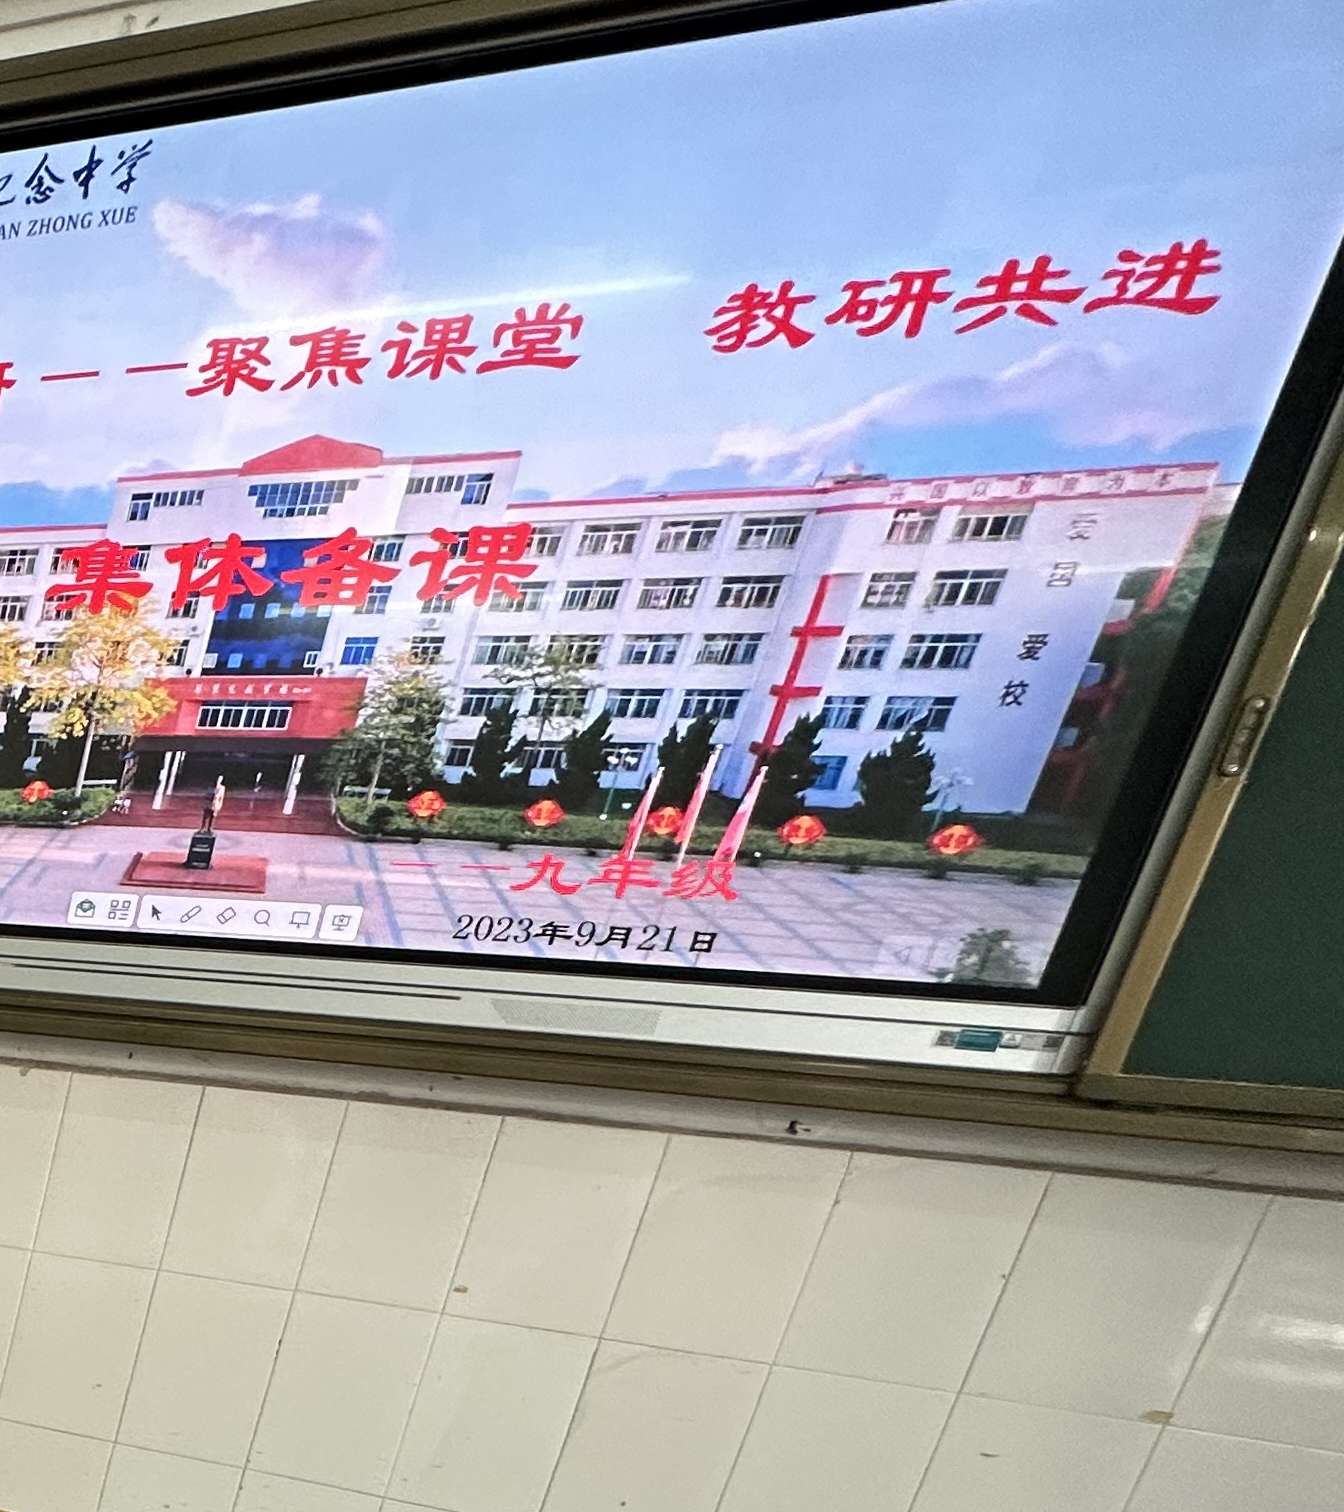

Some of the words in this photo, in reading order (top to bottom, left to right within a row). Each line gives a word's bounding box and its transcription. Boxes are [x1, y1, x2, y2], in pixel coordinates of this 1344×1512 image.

[25, 212, 93, 239] ZHONG
[97, 205, 139, 229] XUE
[702, 238, 1223, 354] 教研共进
[45, 521, 543, 616] 集体备课
[451, 914, 719, 954] 2023年9月21日
